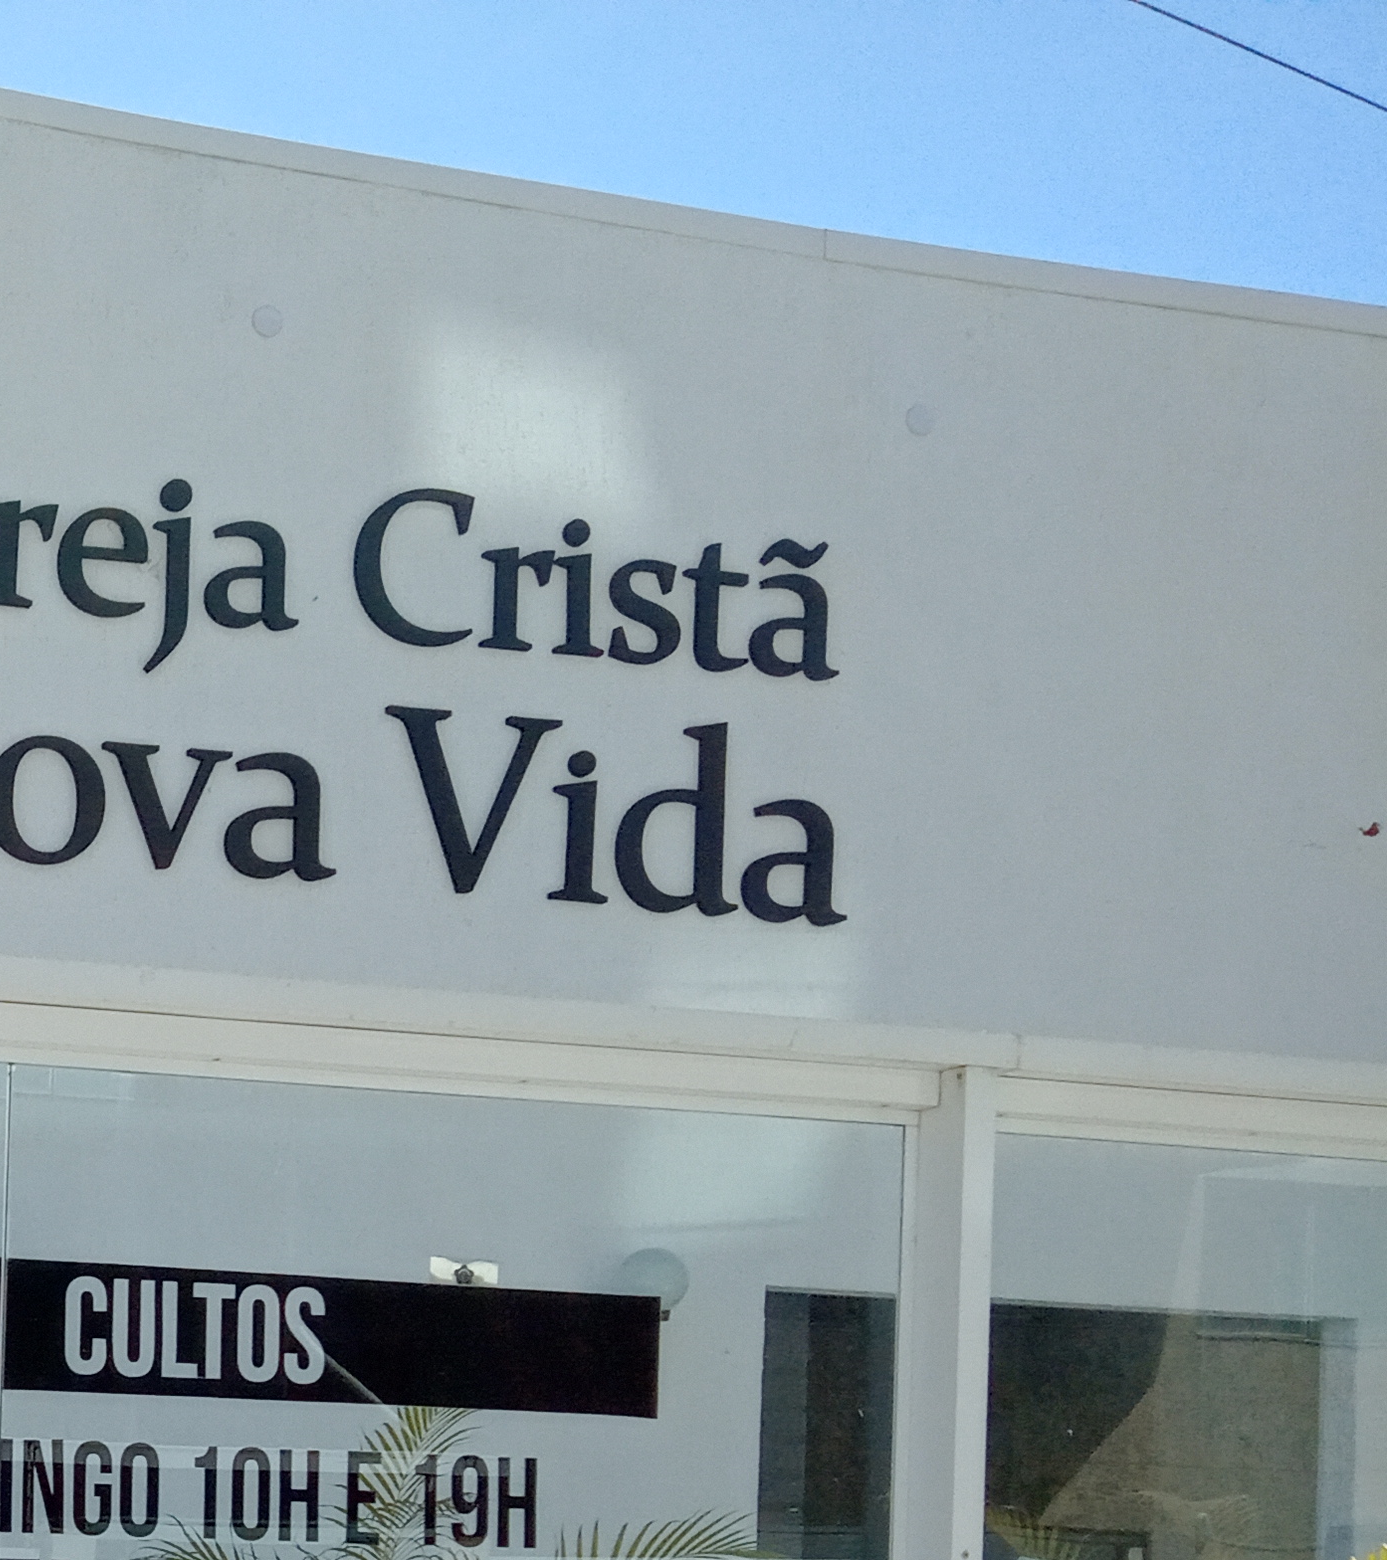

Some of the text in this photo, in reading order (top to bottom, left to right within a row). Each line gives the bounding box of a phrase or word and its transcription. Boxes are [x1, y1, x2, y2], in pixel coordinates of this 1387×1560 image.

[352, 487, 840, 682] Cristã
[384, 704, 848, 928] Vida
[63, 1275, 327, 1386] CULTOS
[194, 1445, 321, 1543] 10H
[346, 1450, 382, 1546] E
[415, 1453, 538, 1549] 19H
